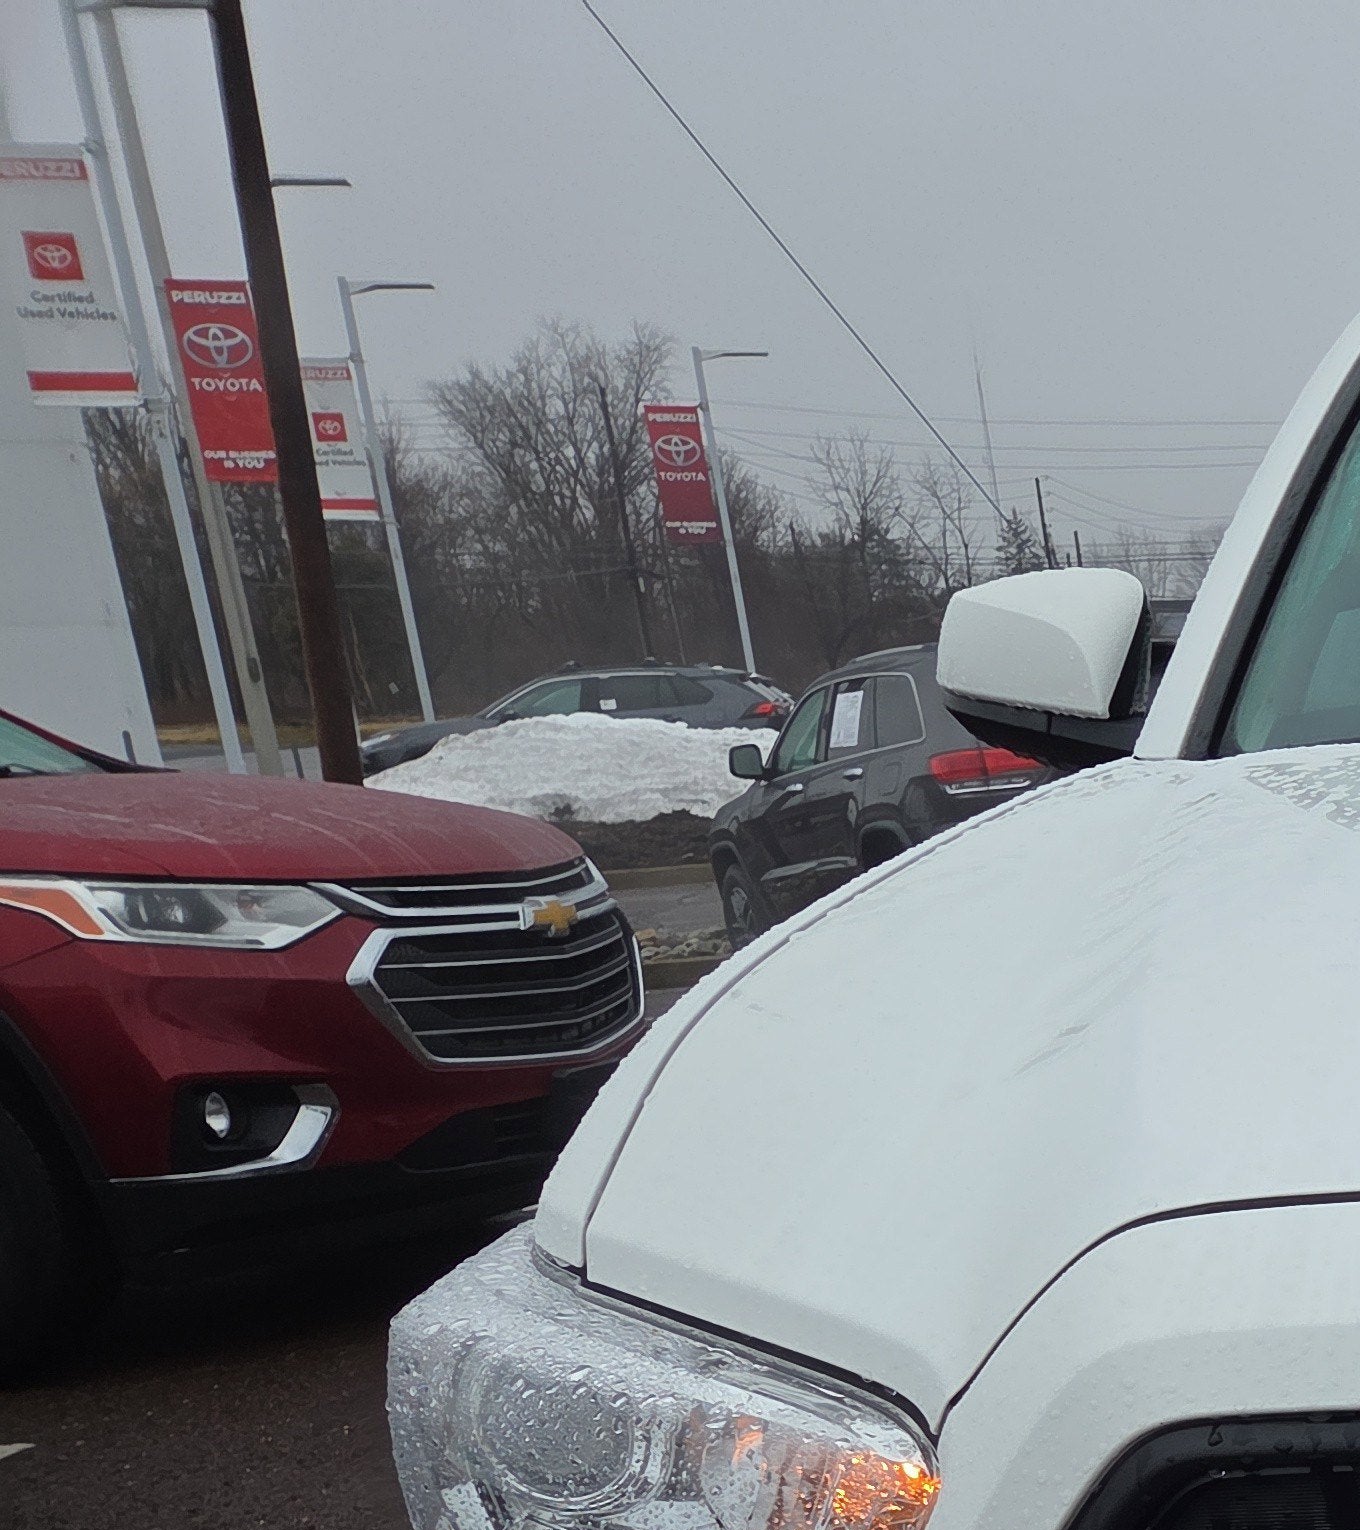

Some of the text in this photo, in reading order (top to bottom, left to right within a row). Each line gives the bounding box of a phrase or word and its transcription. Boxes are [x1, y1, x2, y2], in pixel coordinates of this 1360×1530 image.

[0, 161, 81, 177] ERUZZI
[30, 289, 95, 304] Certified
[171, 290, 246, 304] PERUZZI
[16, 305, 117, 321] Used Vehicles
[191, 377, 263, 393] TOYOTA
[236, 458, 266, 469] YOU
[659, 471, 706, 482] TOYOTA
